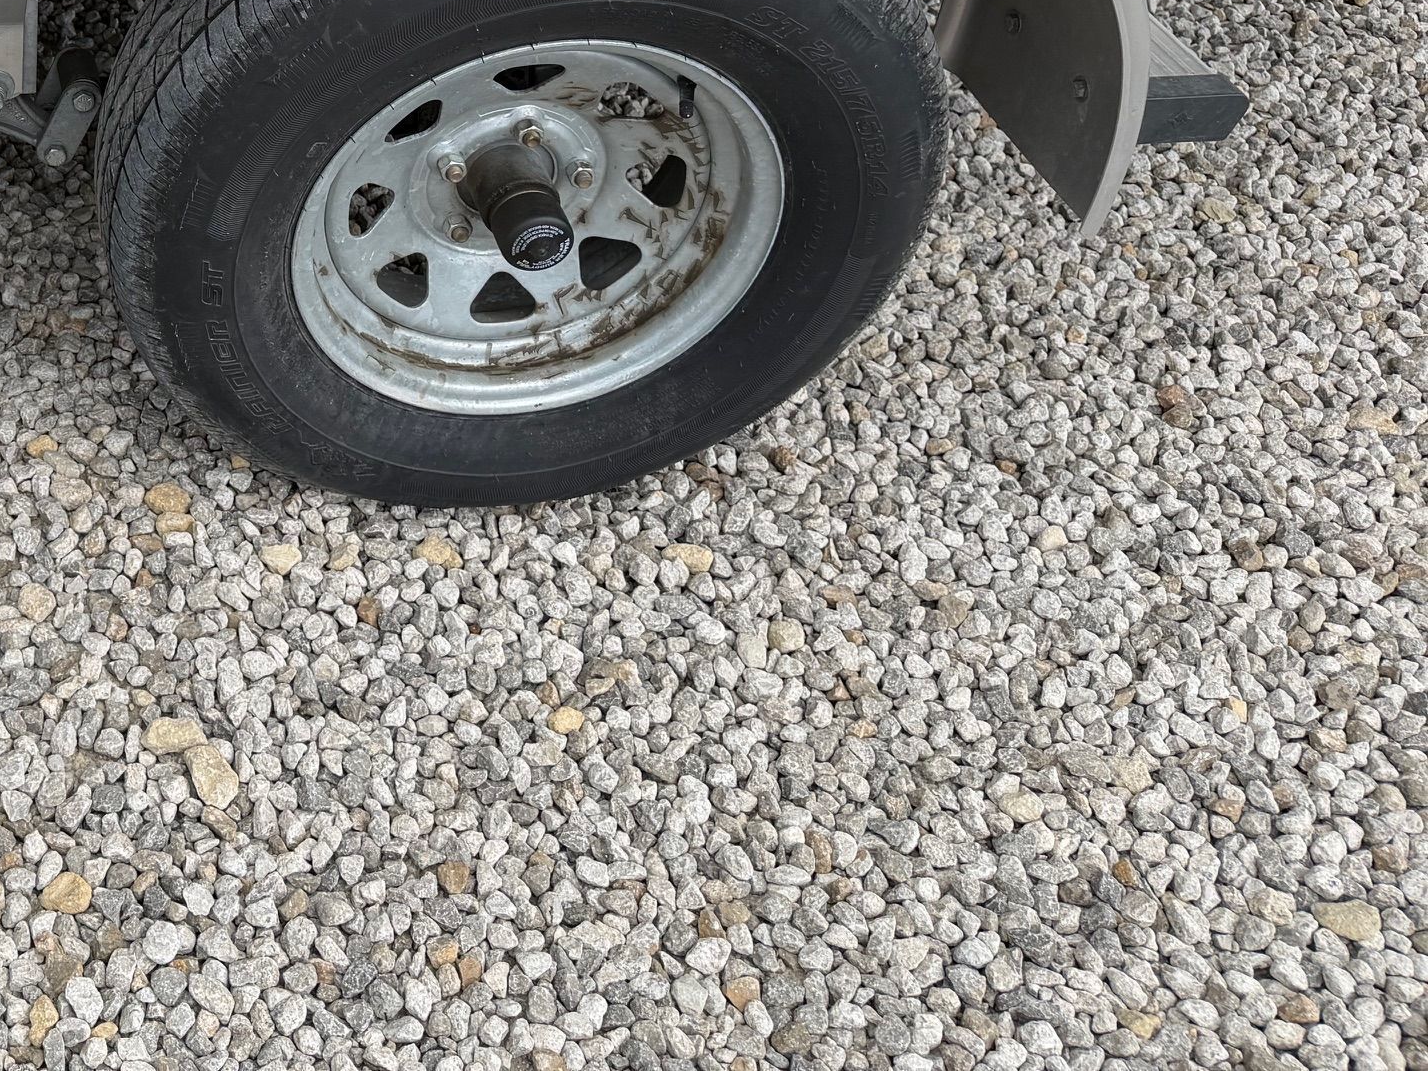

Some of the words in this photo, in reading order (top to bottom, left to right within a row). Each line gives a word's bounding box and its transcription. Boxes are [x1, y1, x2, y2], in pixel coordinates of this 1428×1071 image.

[742, 1, 810, 44] ST
[795, 36, 890, 199] 215/75R14
[197, 258, 227, 306] ST
[200, 319, 299, 436] RAINIER
